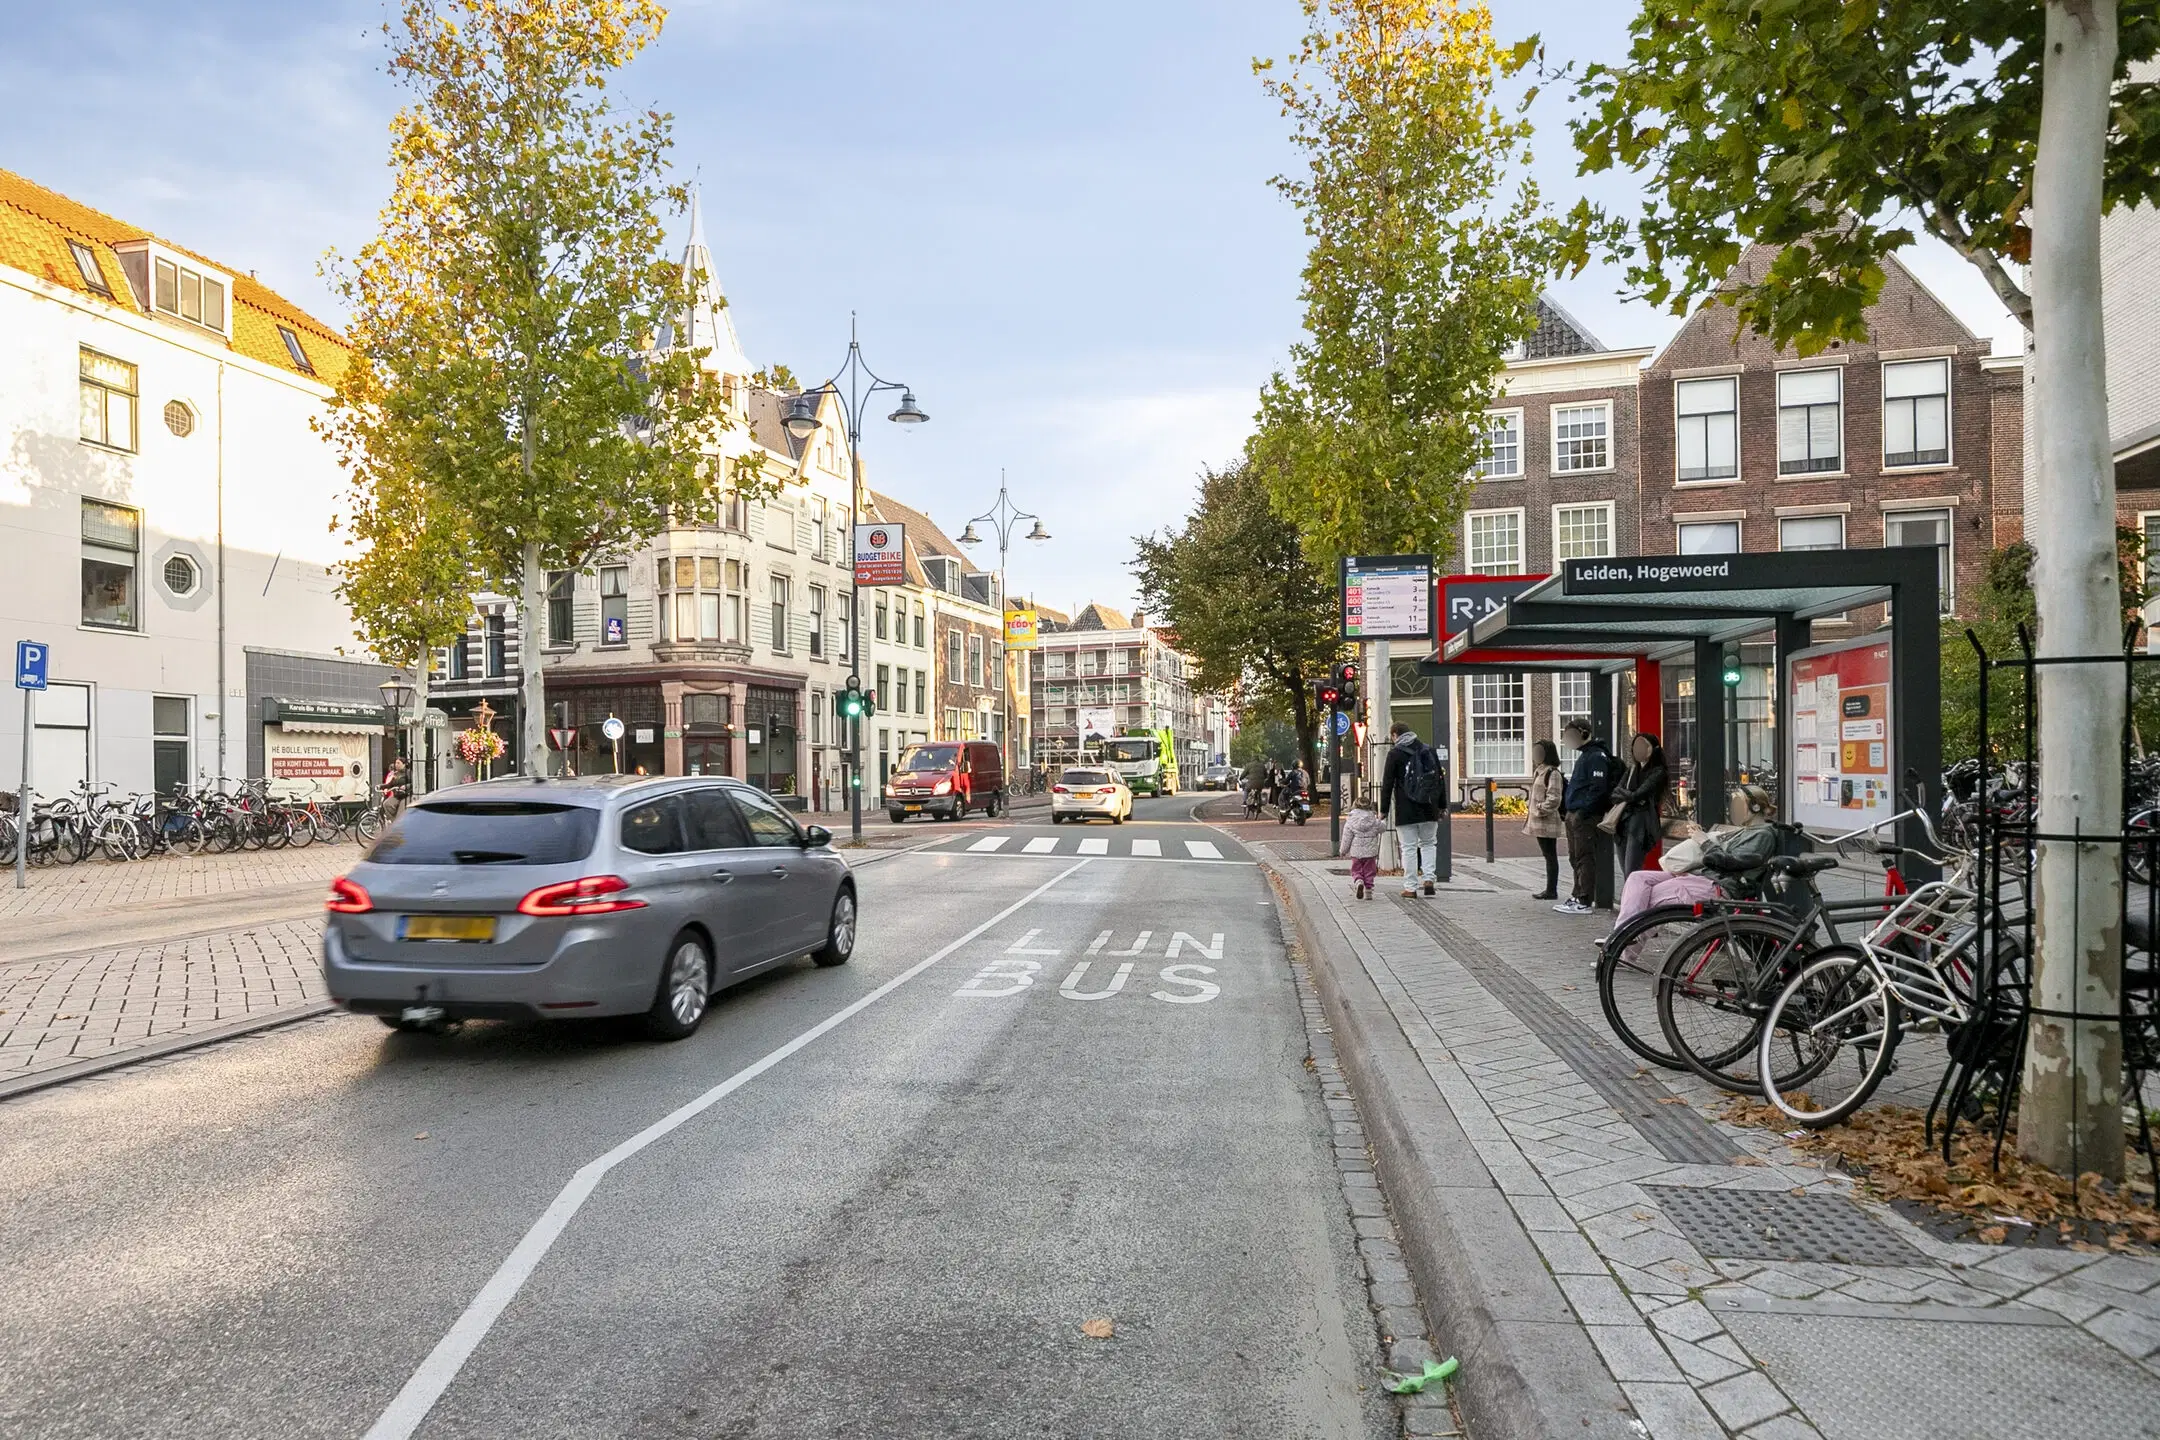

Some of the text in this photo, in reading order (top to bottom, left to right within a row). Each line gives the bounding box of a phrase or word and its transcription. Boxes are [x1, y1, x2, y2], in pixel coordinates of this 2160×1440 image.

[857, 552, 902, 561] BUDGETBIKE
[1576, 562, 1729, 582] Leiden, Hogewoerd
[25, 646, 41, 670] P
[430, 714, 445, 726] Friet
[1003, 928, 1224, 959] LIJN
[952, 960, 1221, 1004] BUS
